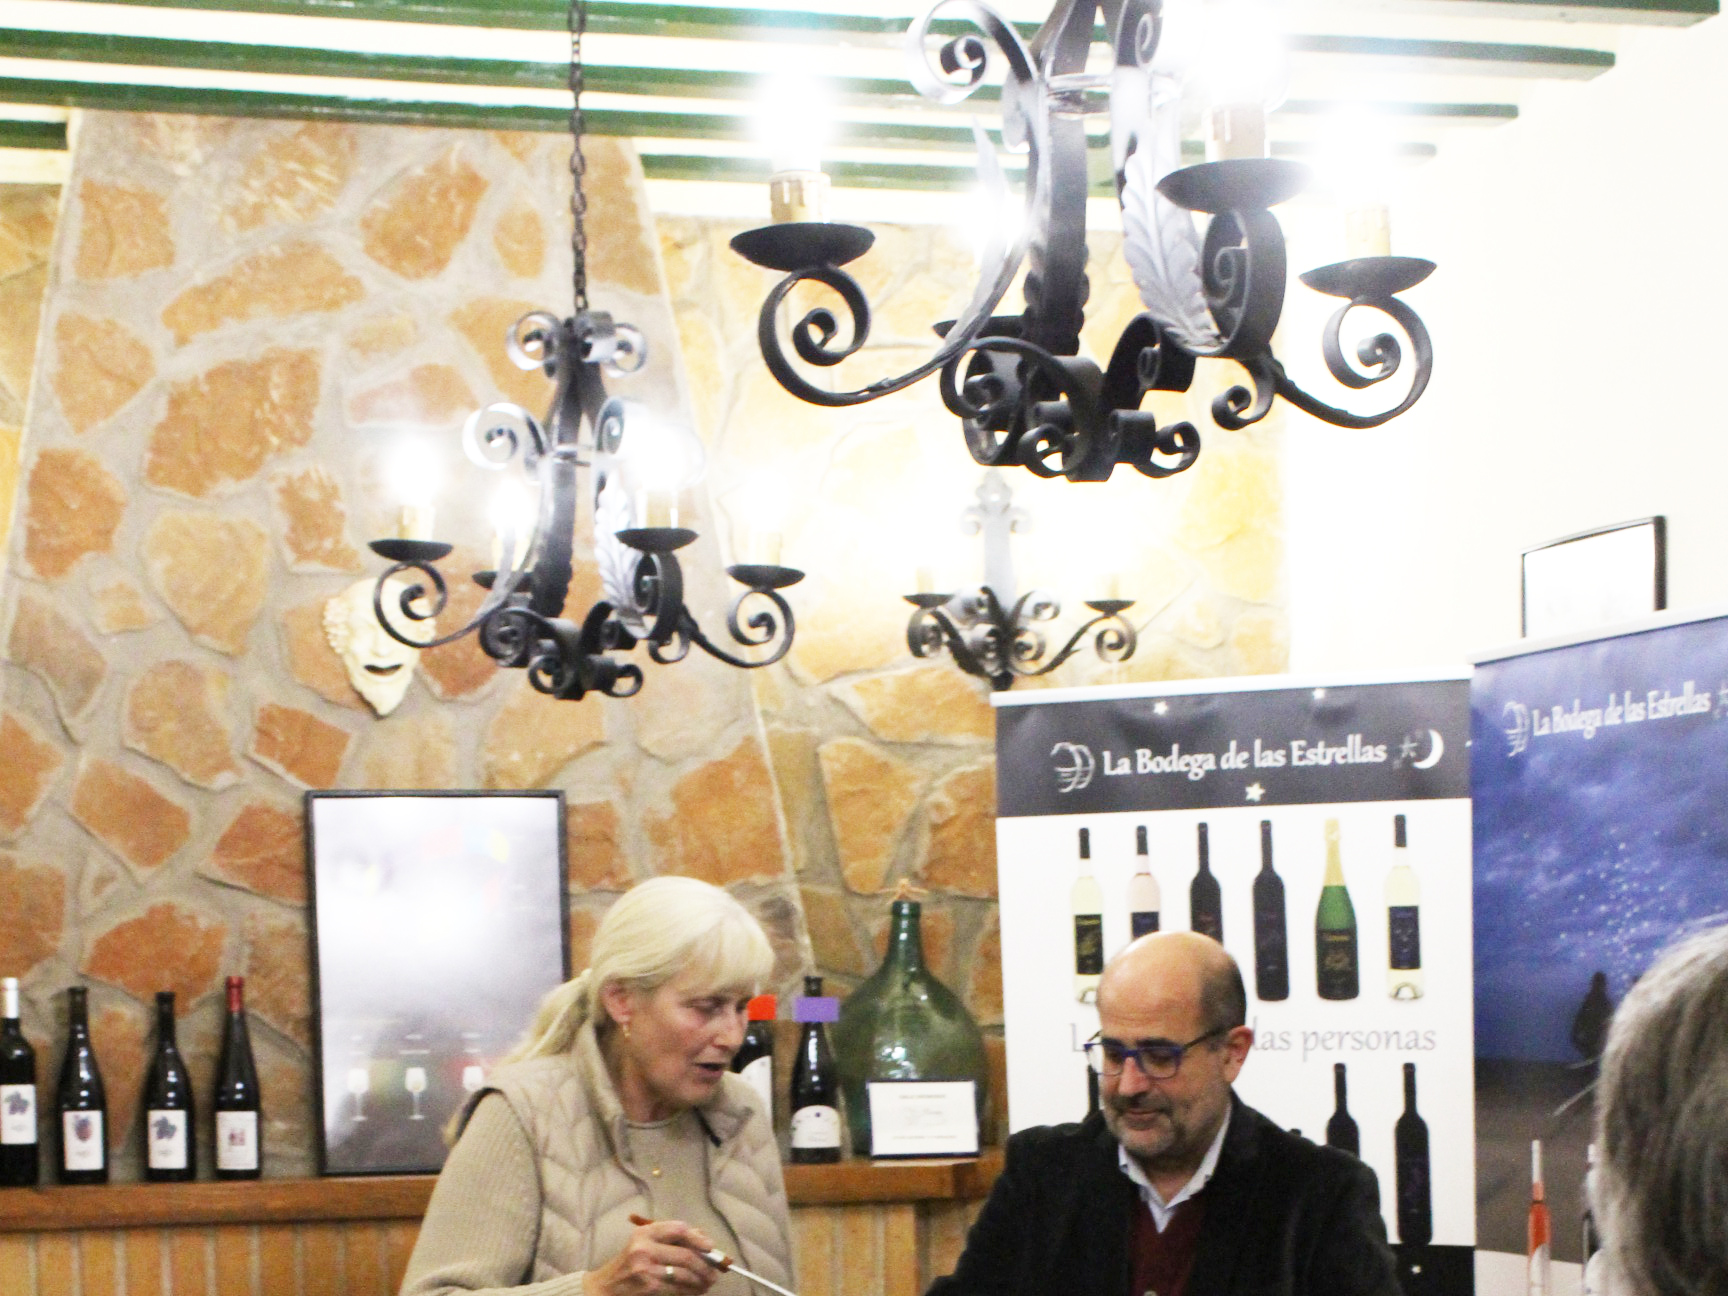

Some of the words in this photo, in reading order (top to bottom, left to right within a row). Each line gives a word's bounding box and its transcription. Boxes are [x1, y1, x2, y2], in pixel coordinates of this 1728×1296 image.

[1533, 708, 1551, 737] La
[1552, 698, 1603, 740] Bodega
[1604, 692, 1623, 726] de
[1624, 690, 1647, 723] las
[1647, 680, 1712, 720] Estrellas
[1102, 750, 1132, 776] La
[1135, 743, 1217, 781] Bodega
[1220, 740, 1249, 771] de
[1254, 738, 1287, 769] las
[1289, 733, 1388, 768] Estrellas
[1301, 1027, 1437, 1063] personas
